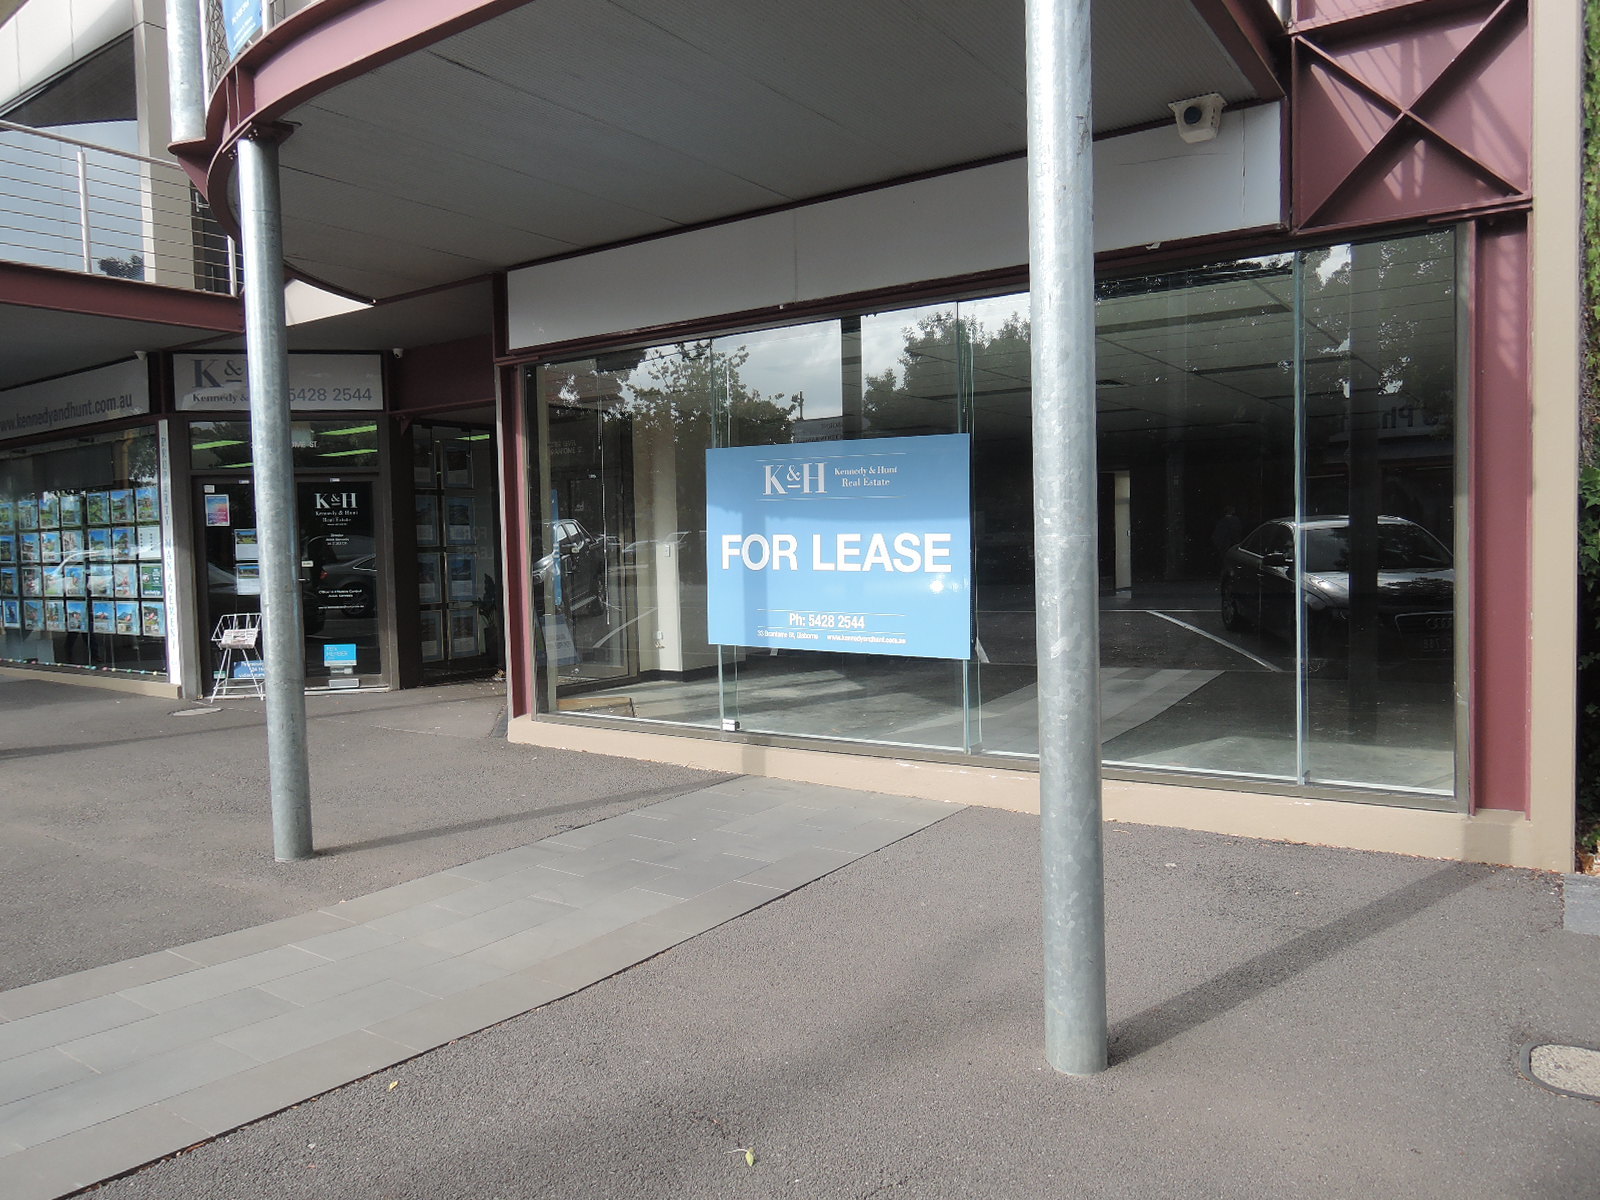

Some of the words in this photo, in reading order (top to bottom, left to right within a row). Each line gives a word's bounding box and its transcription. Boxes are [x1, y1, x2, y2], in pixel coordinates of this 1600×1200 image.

[191, 358, 248, 388] K&
[192, 393, 237, 404] Kennedy
[289, 387, 327, 402] 5428
[332, 387, 373, 402] 2544
[763, 461, 828, 496] K&H
[834, 466, 867, 478] Kennedy
[868, 465, 877, 475] &
[878, 465, 898, 475] Hunt
[842, 477, 862, 488] Real
[864, 476, 890, 487] Estate
[313, 492, 359, 509] K&H
[720, 532, 799, 572] FOR
[811, 532, 952, 573] LEASE
[788, 611, 806, 627] Ph:
[808, 613, 835, 629] 5428
[837, 615, 865, 630] 2544
